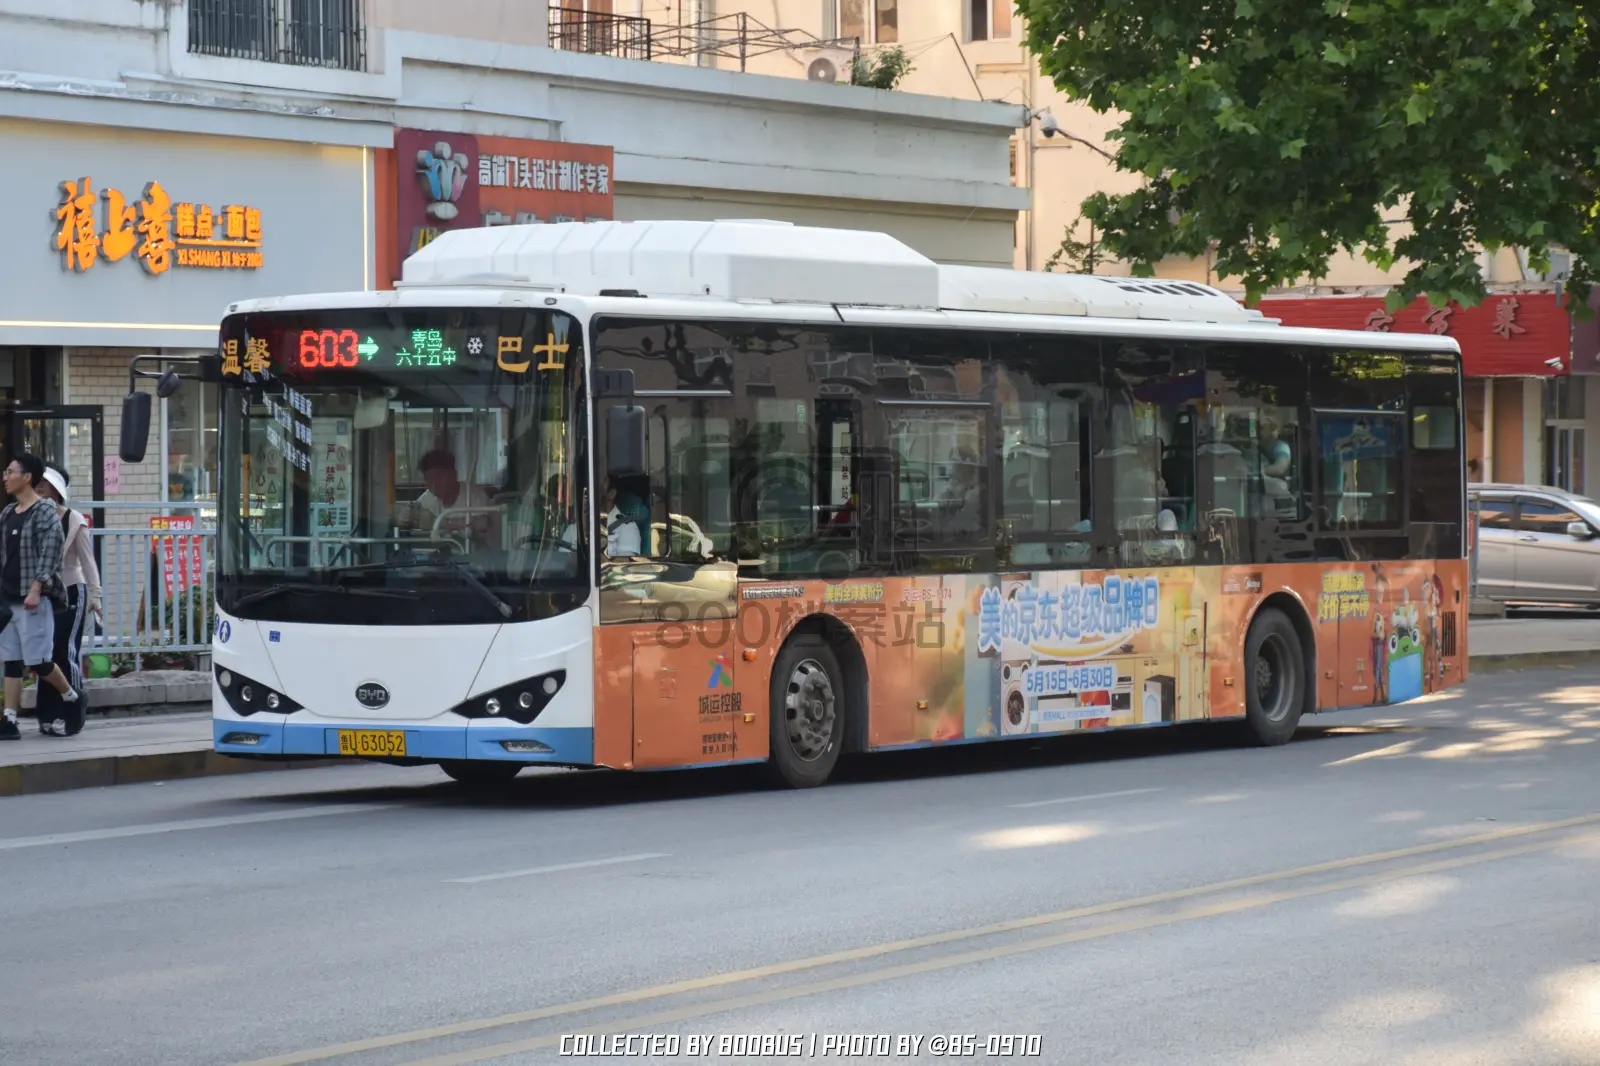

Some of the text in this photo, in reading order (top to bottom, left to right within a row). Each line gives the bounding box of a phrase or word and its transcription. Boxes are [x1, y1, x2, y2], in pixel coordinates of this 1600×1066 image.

[478, 155, 610, 195] 高端门头设计制作专家
[188, 249, 221, 267] SHANG
[300, 329, 359, 368] 603
[412, 328, 443, 349] 青岛
[221, 337, 271, 377] 温馨
[395, 346, 457, 366] 六十五中
[497, 333, 570, 373] 巴士
[978, 575, 1160, 652] 美的京东超级品牌日
[1026, 666, 1113, 692] 5月15日-6月30日
[358, 688, 387, 702] BYD
[699, 692, 742, 714] 城运控股
